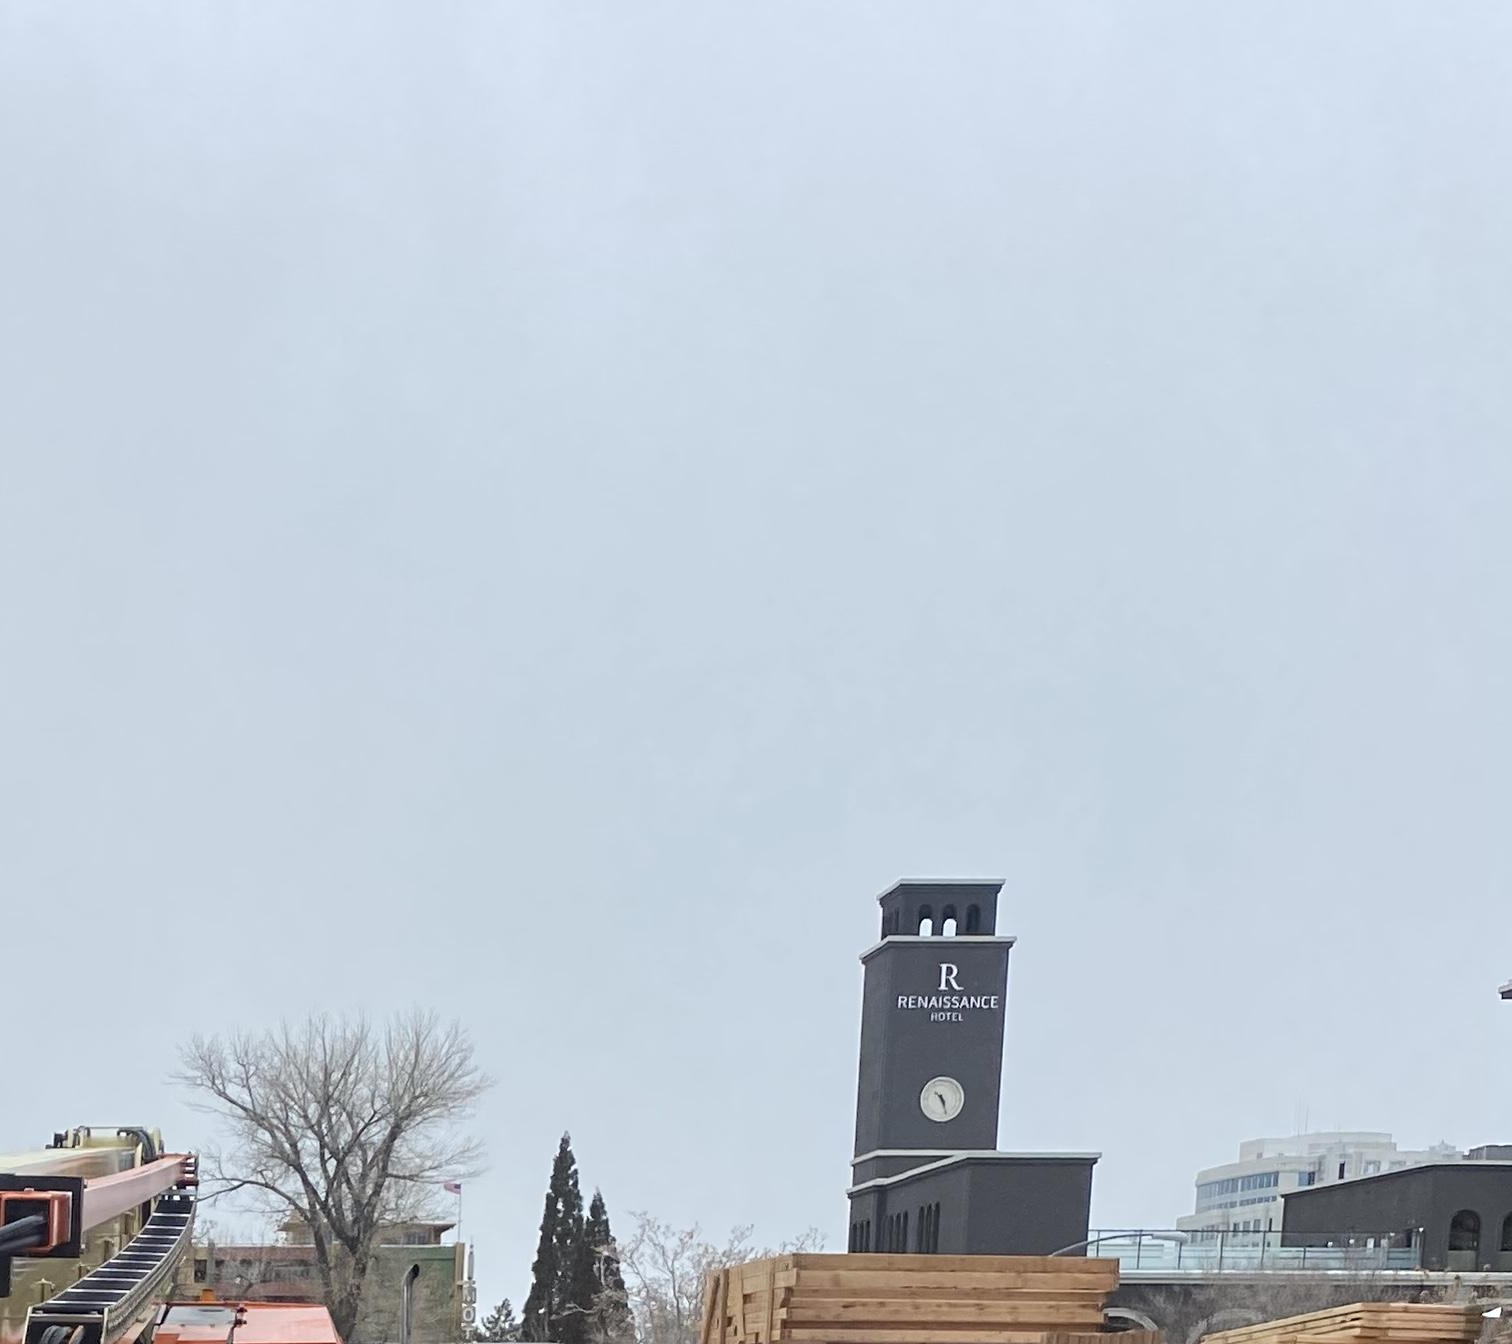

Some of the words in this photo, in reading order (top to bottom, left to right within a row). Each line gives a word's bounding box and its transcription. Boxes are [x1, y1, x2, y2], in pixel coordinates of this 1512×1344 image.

[937, 963, 964, 990] R
[897, 995, 999, 1009] RENAISSANCE
[930, 1012, 964, 1022] HOTEL
